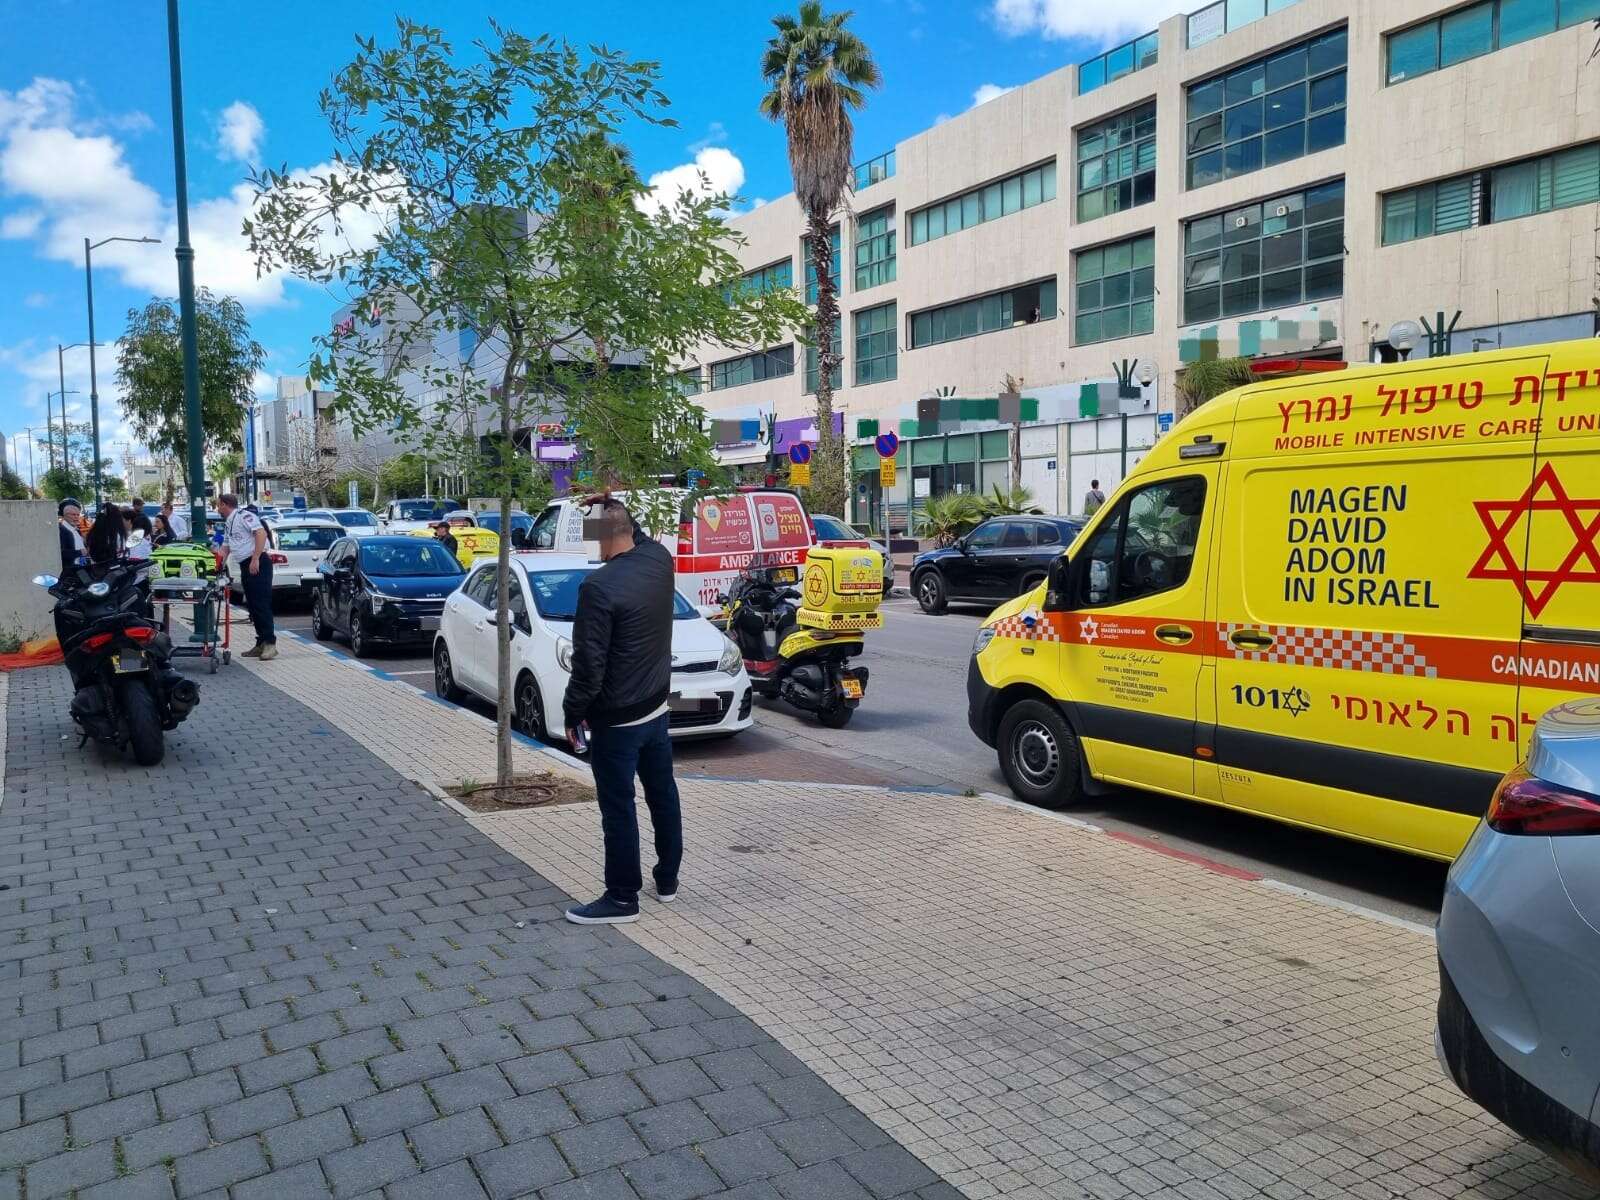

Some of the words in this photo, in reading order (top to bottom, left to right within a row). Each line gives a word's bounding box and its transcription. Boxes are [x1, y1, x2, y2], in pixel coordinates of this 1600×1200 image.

[1377, 381, 1483, 416] טיפול
[1278, 395, 1352, 433] נמרץ
[1275, 433, 1344, 450] MOBILE
[1355, 423, 1465, 445] INTENSIVE
[1479, 418, 1543, 437] CARE
[1290, 485, 1407, 513] MAGEN
[777, 512, 800, 524] מציל
[780, 525, 802, 535] חיים
[1288, 517, 1386, 543] DAVID
[1286, 547, 1385, 574] ADOM
[1285, 577, 1315, 603] IN
[1328, 578, 1439, 608] ISRAEL
[1491, 655, 1599, 683] CANADIAN
[1231, 684, 1279, 709] 101
[1330, 695, 1470, 736] הלאומי
